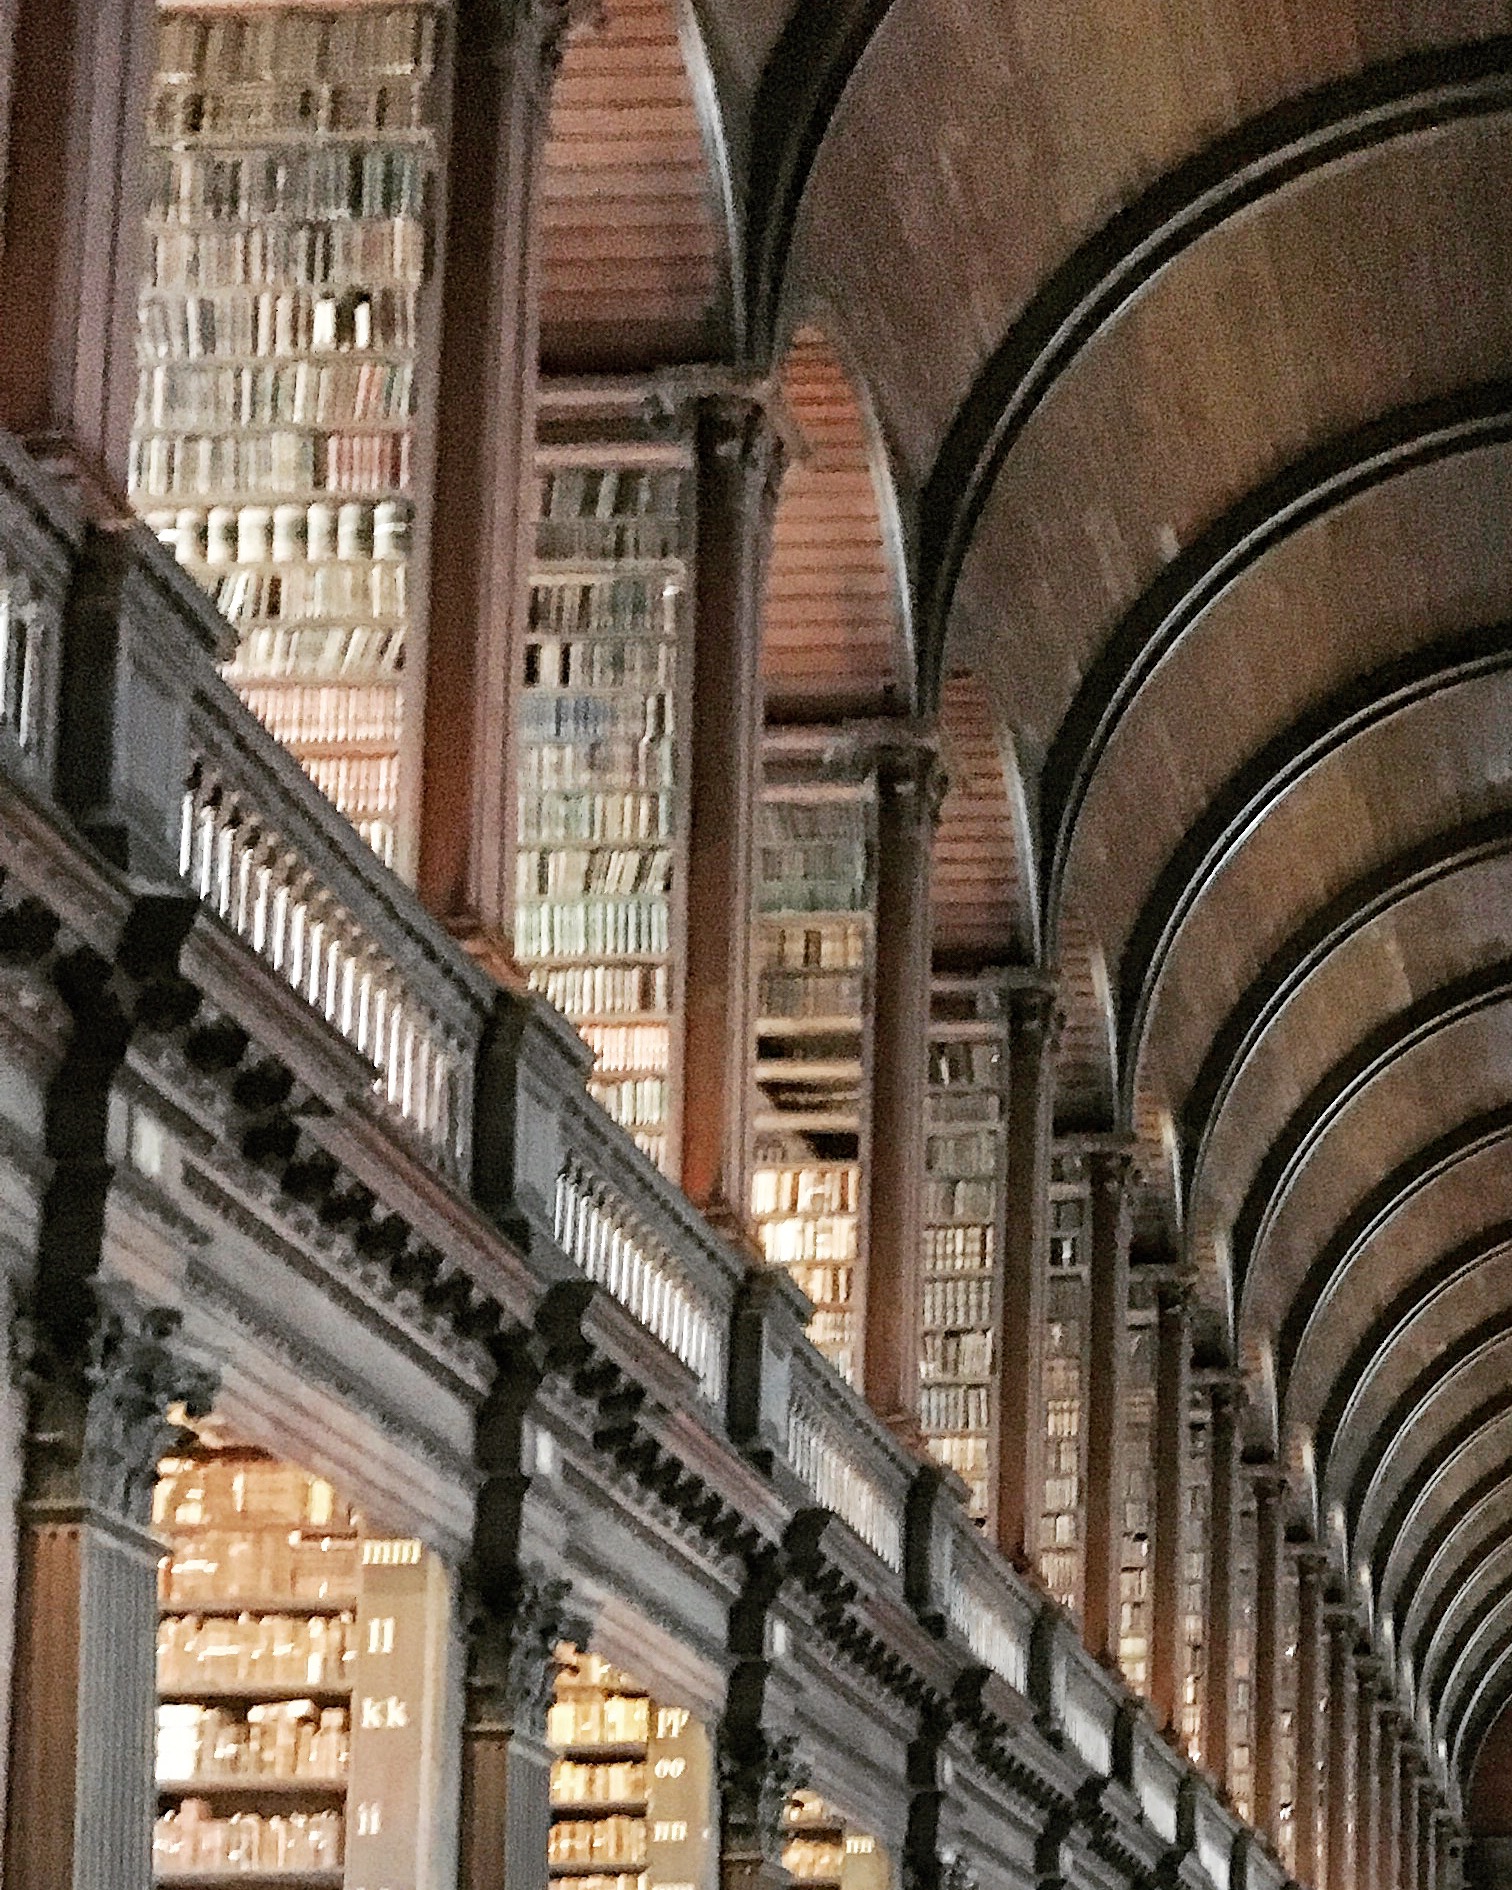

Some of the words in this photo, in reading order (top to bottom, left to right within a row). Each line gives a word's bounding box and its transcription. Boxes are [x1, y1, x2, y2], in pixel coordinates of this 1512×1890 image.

[361, 1537, 423, 1565] mm
[367, 1616, 396, 1653] ll
[361, 1695, 410, 1729] kk
[358, 1801, 382, 1836] ii
